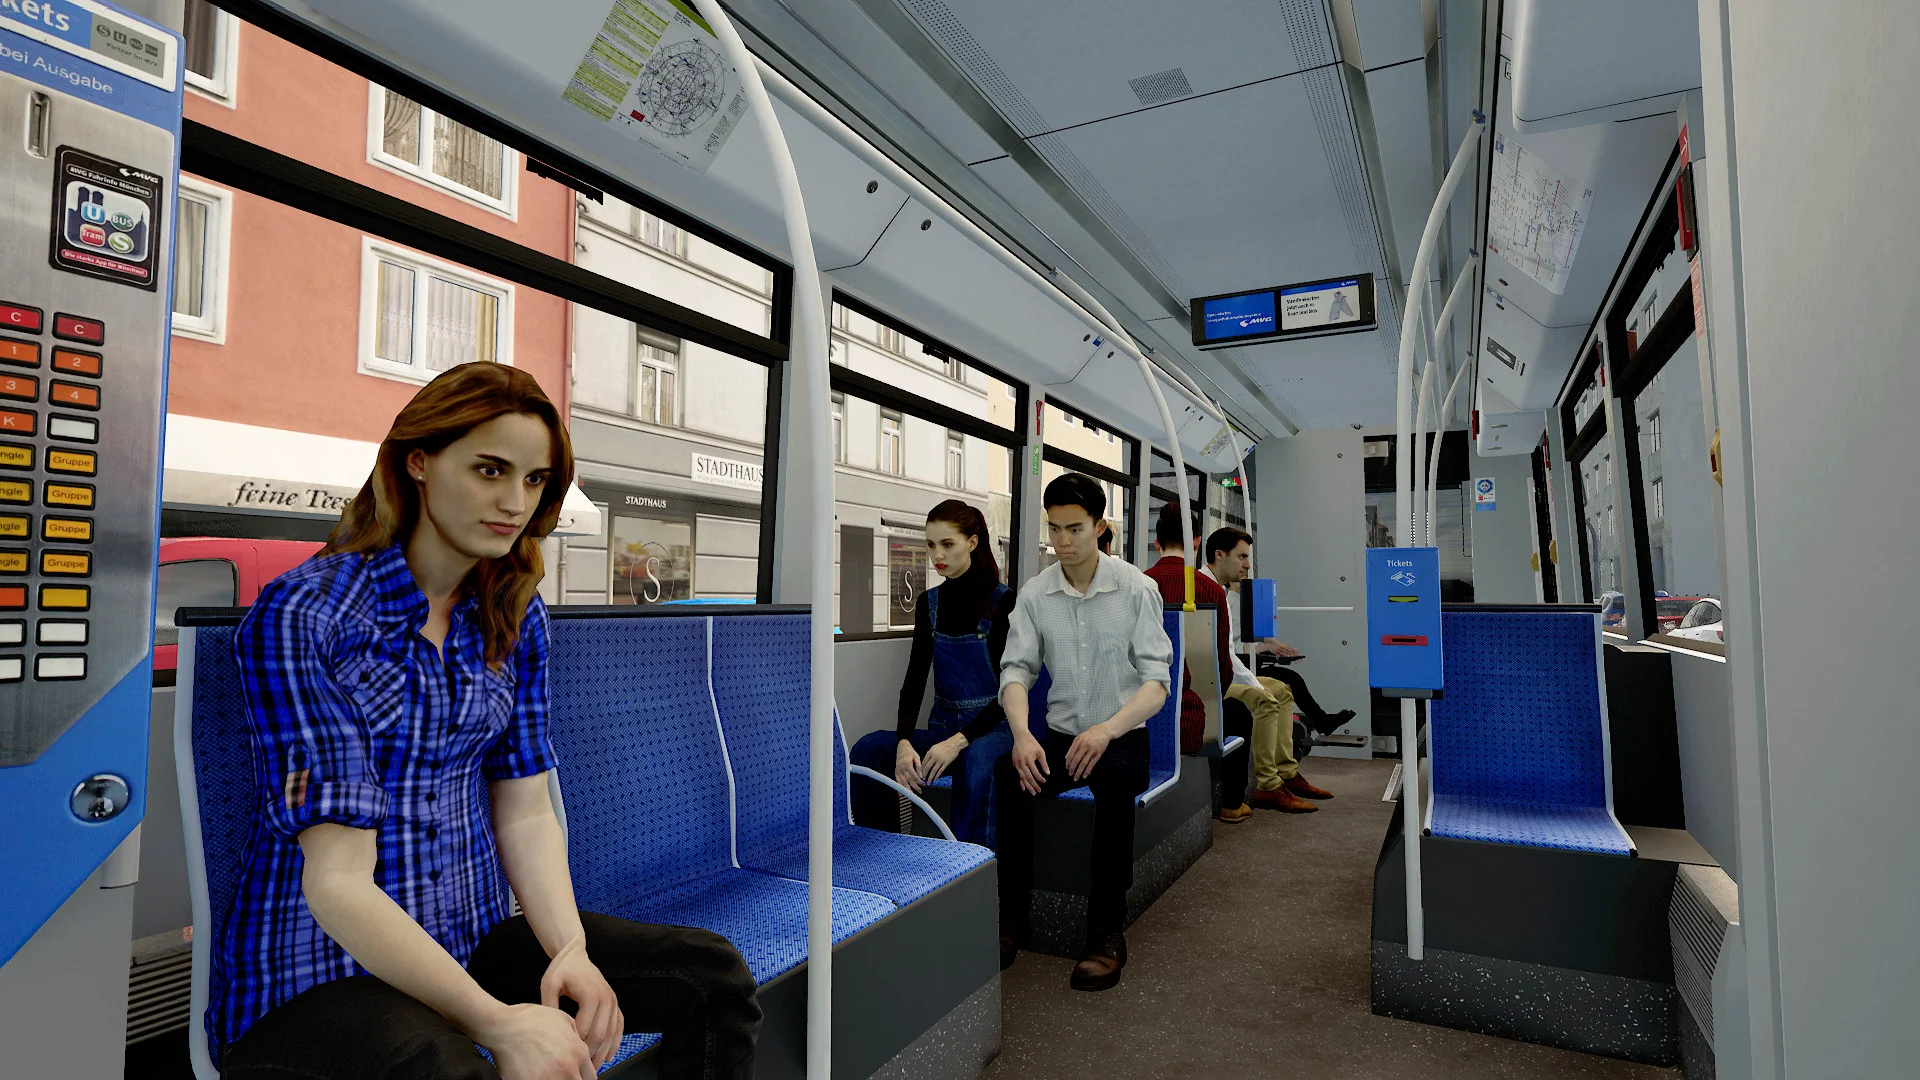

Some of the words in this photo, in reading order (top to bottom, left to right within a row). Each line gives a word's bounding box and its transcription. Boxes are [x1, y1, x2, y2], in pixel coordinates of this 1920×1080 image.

[0, 43, 29, 64] bei
[33, 56, 113, 94] Ausgabe
[69, 166, 88, 177] MVG
[88, 172, 118, 186] Fahrinfo
[118, 181, 150, 196] München
[132, 171, 159, 184] MVG
[87, 205, 101, 221] U
[112, 214, 134, 228] BUS
[82, 228, 104, 241] Tram
[112, 234, 130, 251] S
[95, 258, 108, 267] App
[10, 312, 22, 323] C
[1249, 316, 1273, 325] MVG
[73, 324, 85, 335] C
[11, 345, 17, 355] 1
[72, 357, 81, 368] 2
[6, 380, 17, 391] 3
[70, 390, 79, 400] 4
[3, 416, 16, 427] K
[53, 456, 91, 467] Gruppe
[696, 456, 764, 484] STADTHAUS
[51, 489, 89, 501] Gruppe
[227, 481, 299, 507] feine
[625, 495, 667, 508] STADTHAUS
[49, 523, 87, 534] Gruppe
[47, 558, 85, 570] Gruppe
[1386, 559, 1413, 567] Tickets
[643, 556, 661, 603] S
[904, 570, 913, 603] S
